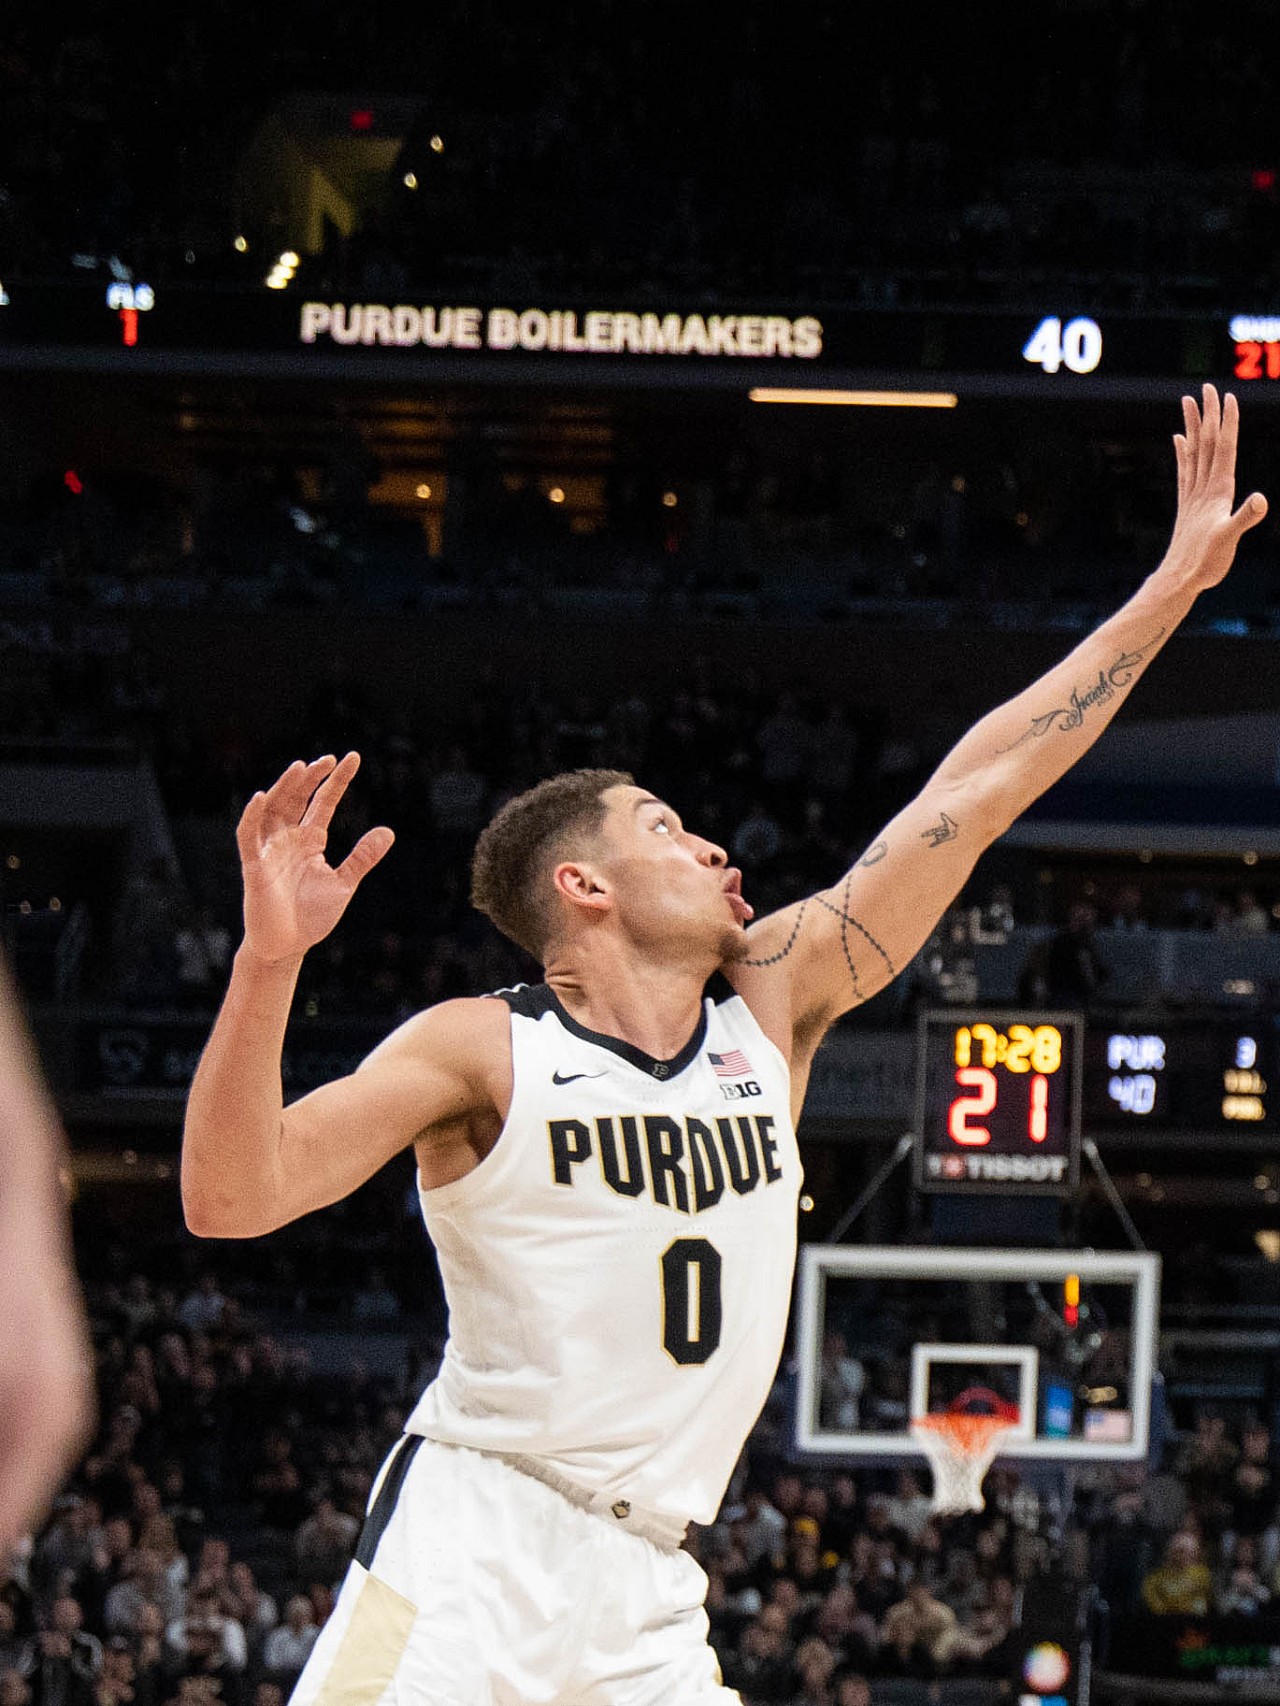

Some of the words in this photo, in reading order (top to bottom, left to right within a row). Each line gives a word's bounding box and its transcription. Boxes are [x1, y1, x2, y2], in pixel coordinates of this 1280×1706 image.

[301, 302, 483, 349] PURDUE
[488, 308, 823, 358] BOILERMAKERS
[1022, 316, 1103, 374] 40
[955, 1023, 1062, 1073] 17:28
[948, 1066, 1048, 1146] 21
[546, 1113, 783, 1217] PURDUE
[658, 1235, 723, 1368] 0
